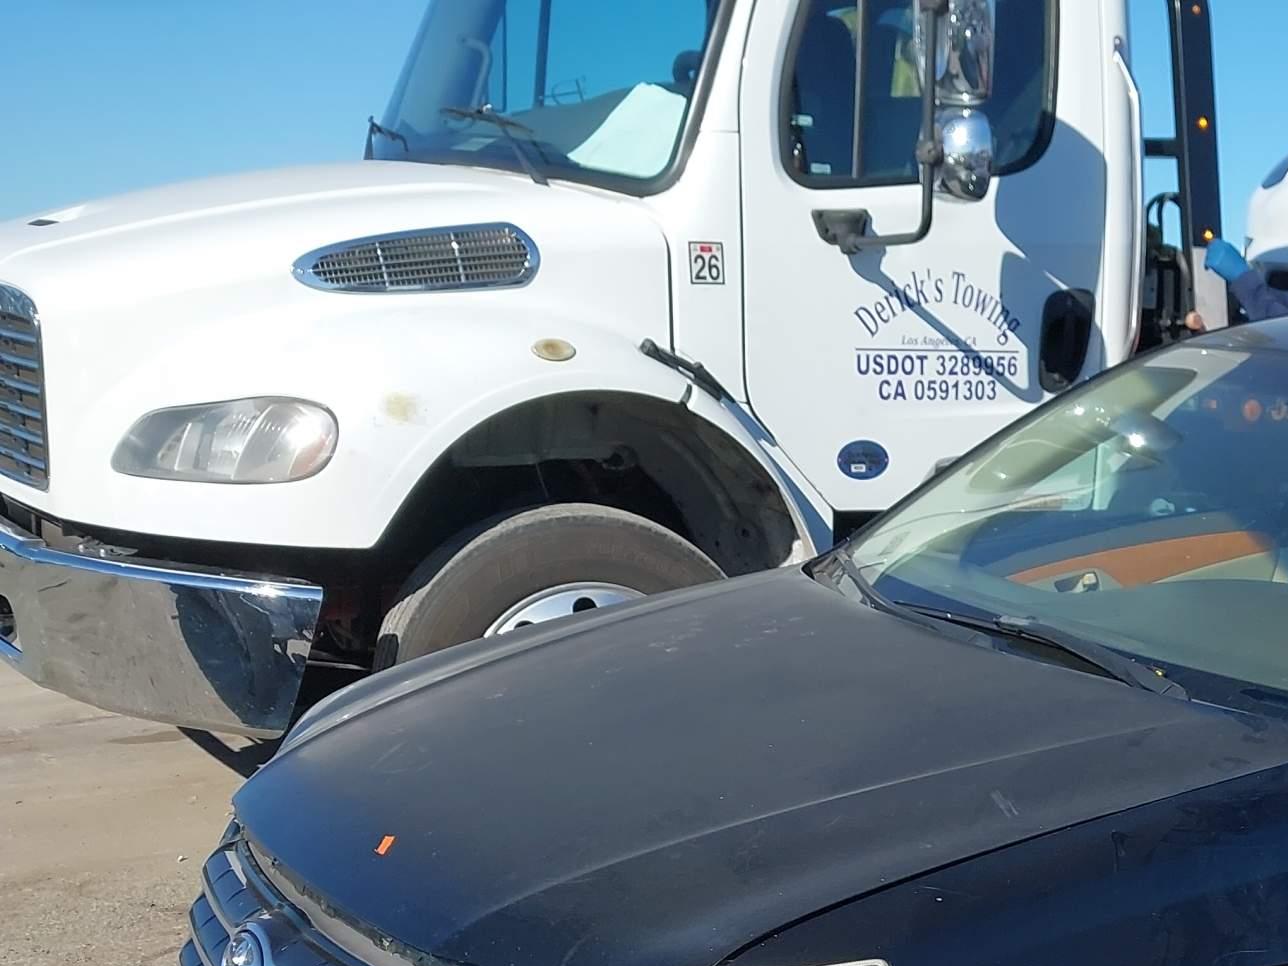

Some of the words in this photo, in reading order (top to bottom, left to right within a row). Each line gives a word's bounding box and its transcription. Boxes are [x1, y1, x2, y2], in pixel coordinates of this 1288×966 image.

[694, 254, 721, 281] 26
[854, 268, 944, 338] Derick's
[952, 271, 1021, 346] Towing
[901, 335, 919, 345] Los
[856, 354, 928, 376] USDOT
[936, 355, 1018, 377] 3289956
[879, 380, 907, 401] CA
[914, 380, 997, 401] 0591303
